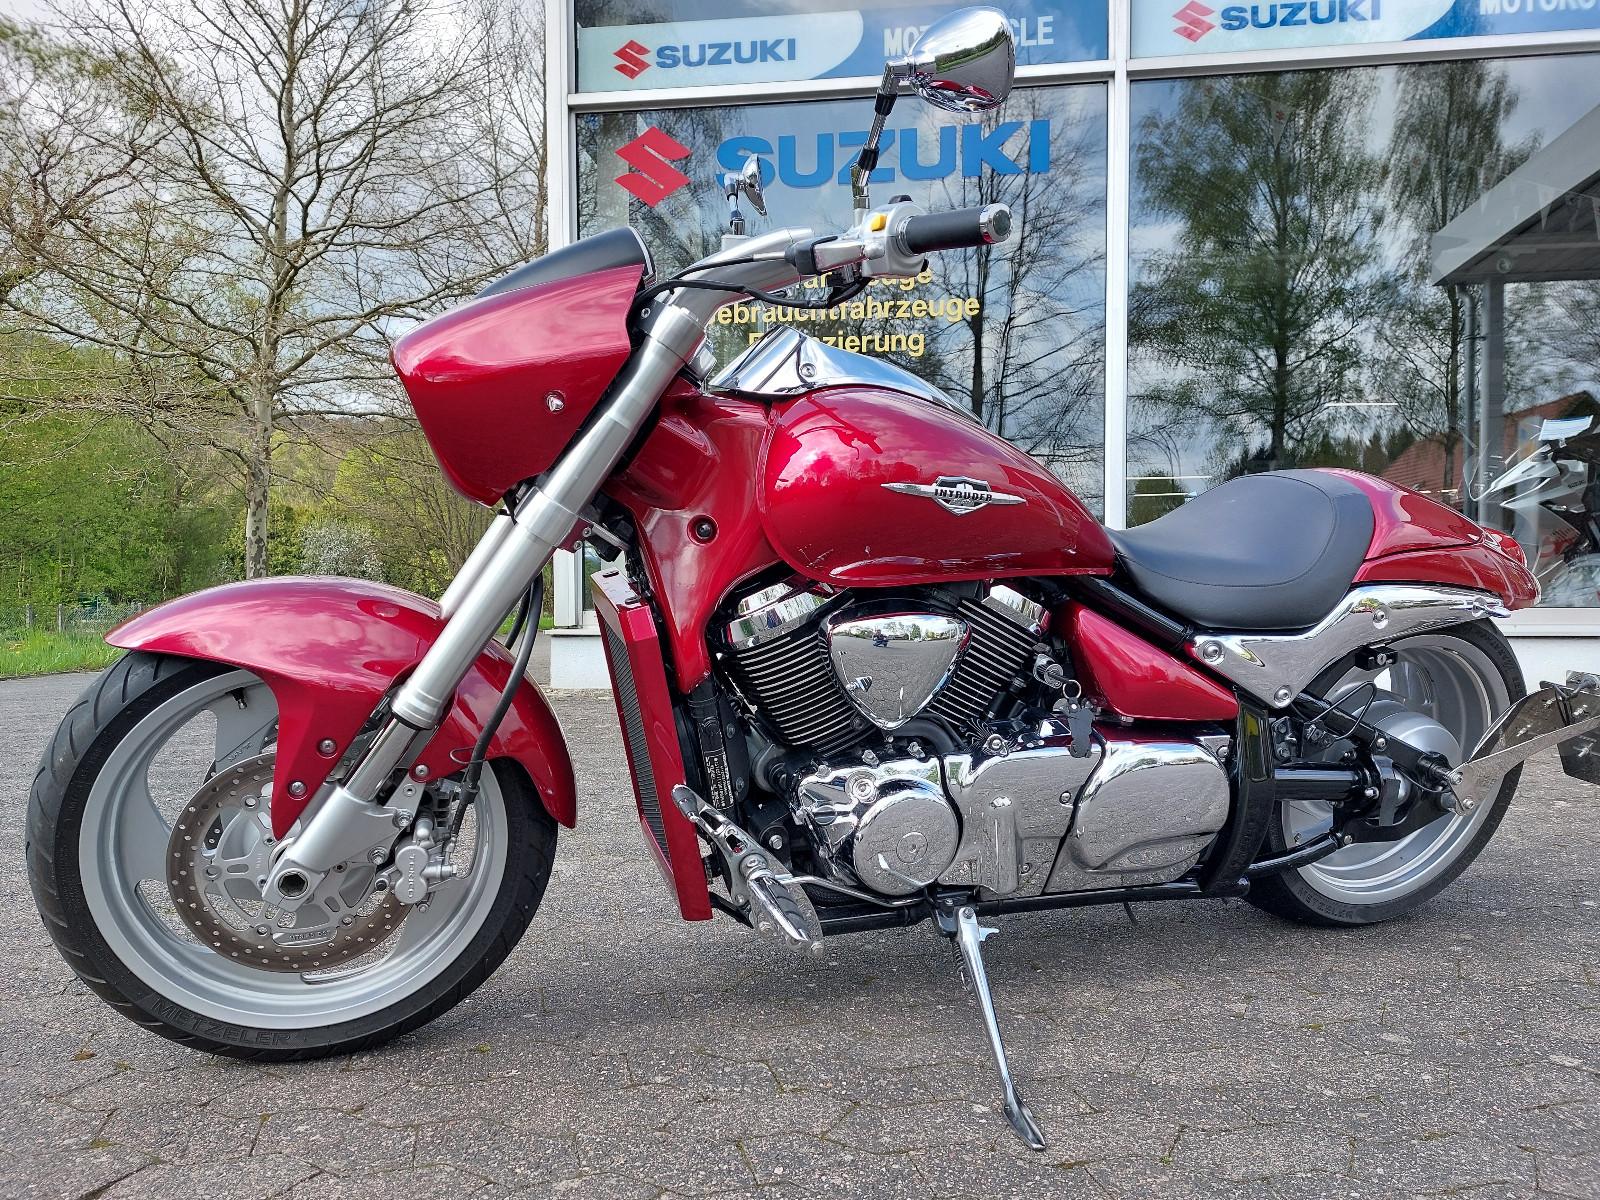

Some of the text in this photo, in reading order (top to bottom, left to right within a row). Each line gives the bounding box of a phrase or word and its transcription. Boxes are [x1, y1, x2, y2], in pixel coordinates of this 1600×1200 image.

[1220, 0, 1381, 31] SUZUKI
[656, 38, 796, 69] SUZUKI
[715, 119, 1051, 189] SUZUKI
[709, 296, 981, 325] ebrauchtfahrzeuge
[749, 330, 925, 357] Fzierung
[934, 488, 993, 502] INTRUDER
[152, 998, 291, 1046] METZELER
